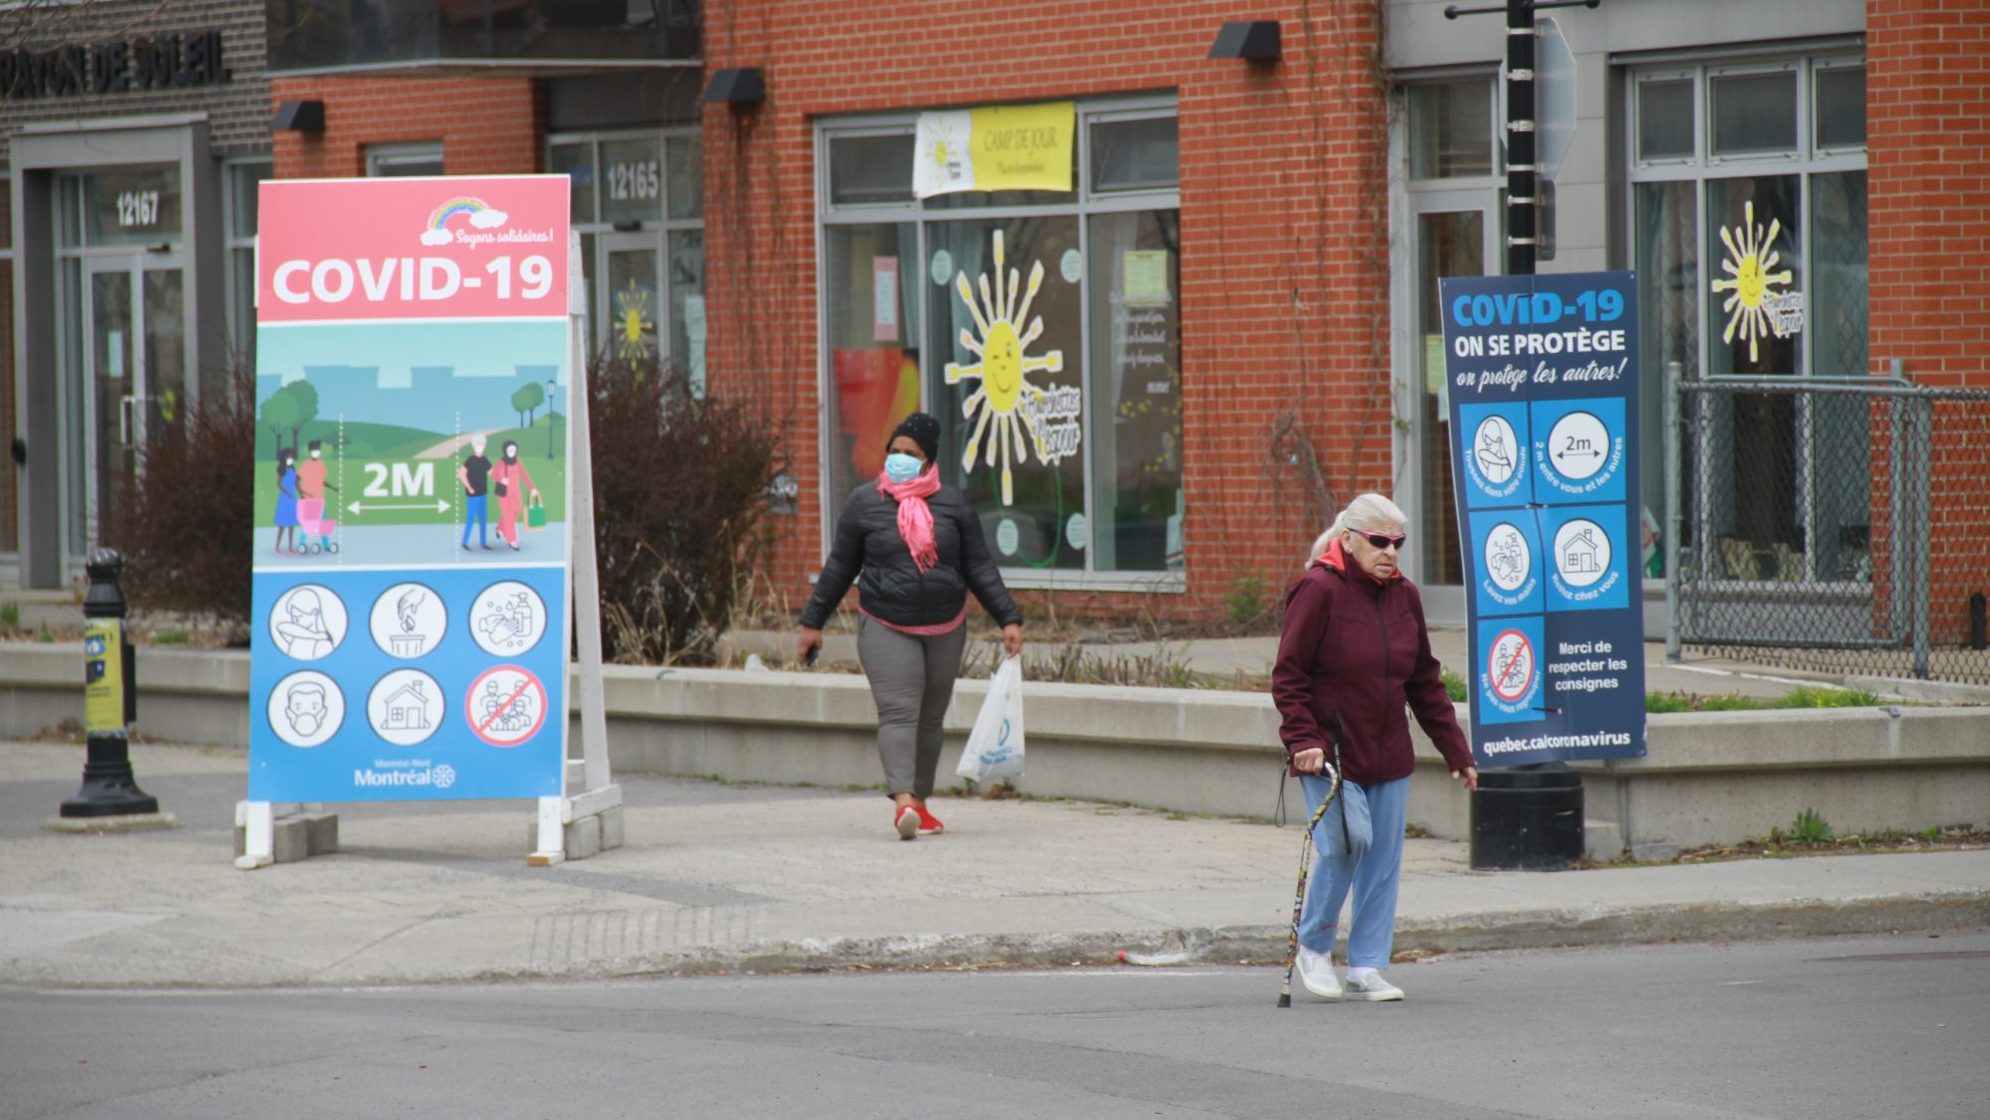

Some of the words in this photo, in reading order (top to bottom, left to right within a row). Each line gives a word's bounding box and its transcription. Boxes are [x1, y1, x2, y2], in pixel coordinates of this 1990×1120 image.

[93, 41, 129, 93] DE
[131, 29, 232, 89] SOLEIL
[984, 128, 1013, 152] CAMP
[1015, 127, 1029, 150] DE
[1028, 126, 1058, 157] JOUR
[608, 161, 659, 199] 12165
[116, 191, 159, 225] 12167
[455, 228, 495, 249] Soyons
[273, 255, 553, 304] COVID-19
[1453, 289, 1625, 327] COVID-19
[1455, 336, 1483, 357] ON
[1488, 334, 1510, 356] SE
[1514, 327, 1626, 355] PROTÈGE
[1456, 370, 1476, 386] on
[1533, 361, 1557, 384] les
[1562, 357, 1628, 382] autres!
[363, 462, 434, 497] 2M
[1538, 463, 1560, 487] entre
[1561, 484, 1584, 494] vous
[1585, 481, 1597, 492] et
[1596, 474, 1611, 487] les
[1609, 437, 1623, 474] autres
[1574, 590, 1600, 601] chez
[1599, 571, 1619, 592] vous
[1559, 641, 1592, 655] Merci
[1594, 641, 1612, 653] de
[1549, 659, 1604, 675] respecter
[1608, 658, 1628, 671] les
[1555, 677, 1619, 692] consignes
[1483, 730, 1631, 757] quebec.ca/coronavirus
[354, 768, 431, 787] Montréal
